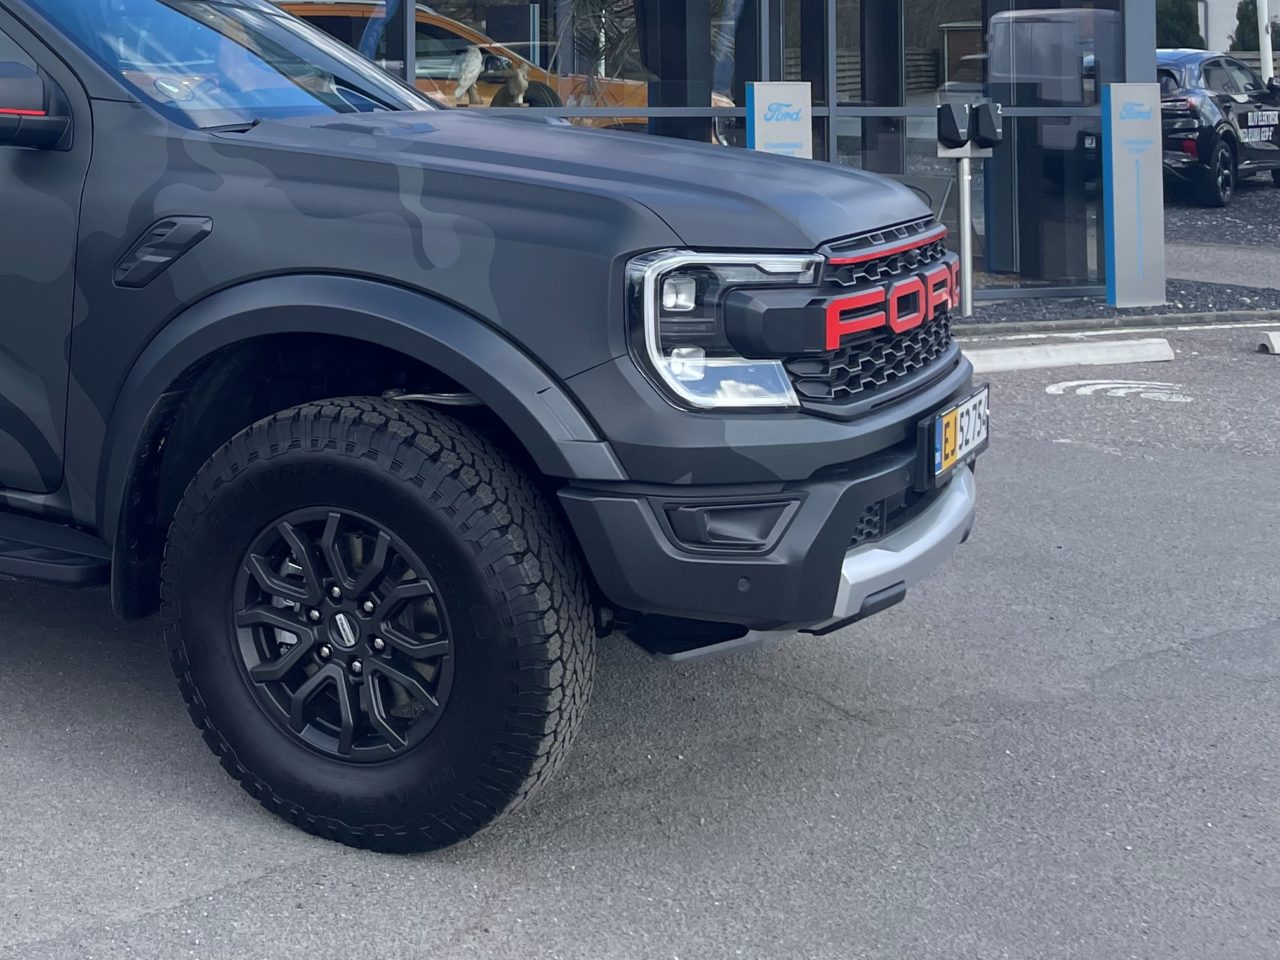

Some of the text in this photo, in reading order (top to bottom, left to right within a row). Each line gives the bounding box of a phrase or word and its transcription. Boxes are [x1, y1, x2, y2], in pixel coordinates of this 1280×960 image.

[764, 102, 802, 122] Ford
[963, 103, 969, 114] 1
[996, 103, 1003, 114] 2
[943, 416, 957, 461] EJ
